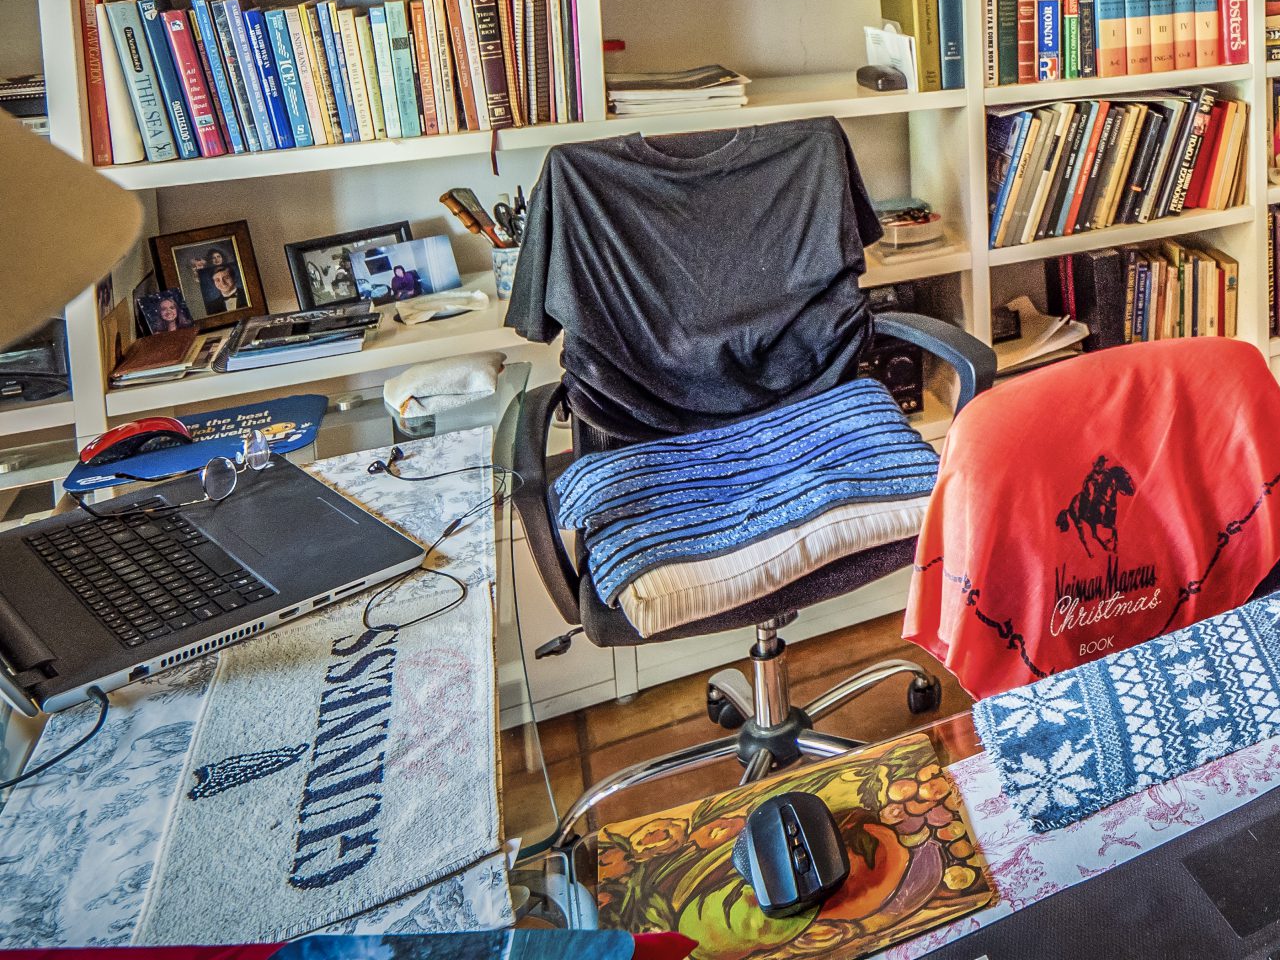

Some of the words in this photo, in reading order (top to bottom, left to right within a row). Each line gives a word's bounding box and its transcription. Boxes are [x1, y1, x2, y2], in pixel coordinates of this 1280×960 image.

[1043, 6, 1053, 47] JUNIOR
[1158, 24, 1168, 33] III
[1179, 22, 1190, 31] IV
[1204, 21, 1211, 29] V
[86, 26, 102, 84] NAVIGATION
[294, 32, 308, 74] ENDURANCE
[279, 58, 296, 87] ICE!
[135, 74, 157, 110] THE
[193, 101, 208, 111] Boat
[143, 110, 164, 138] SEA
[1169, 171, 1188, 213] PERSONAGGI
[1184, 135, 1198, 165] POPOLI
[190, 427, 216, 437] job
[221, 422, 235, 431] is
[241, 415, 273, 428] that
[206, 417, 231, 428] the
[236, 410, 271, 423] best
[1054, 562, 1104, 608] Neiman
[1104, 554, 1157, 600] Marcus
[1049, 588, 1163, 637] Christmas
[1079, 635, 1115, 657] BOOK
[286, 623, 401, 891] GUINNESS
